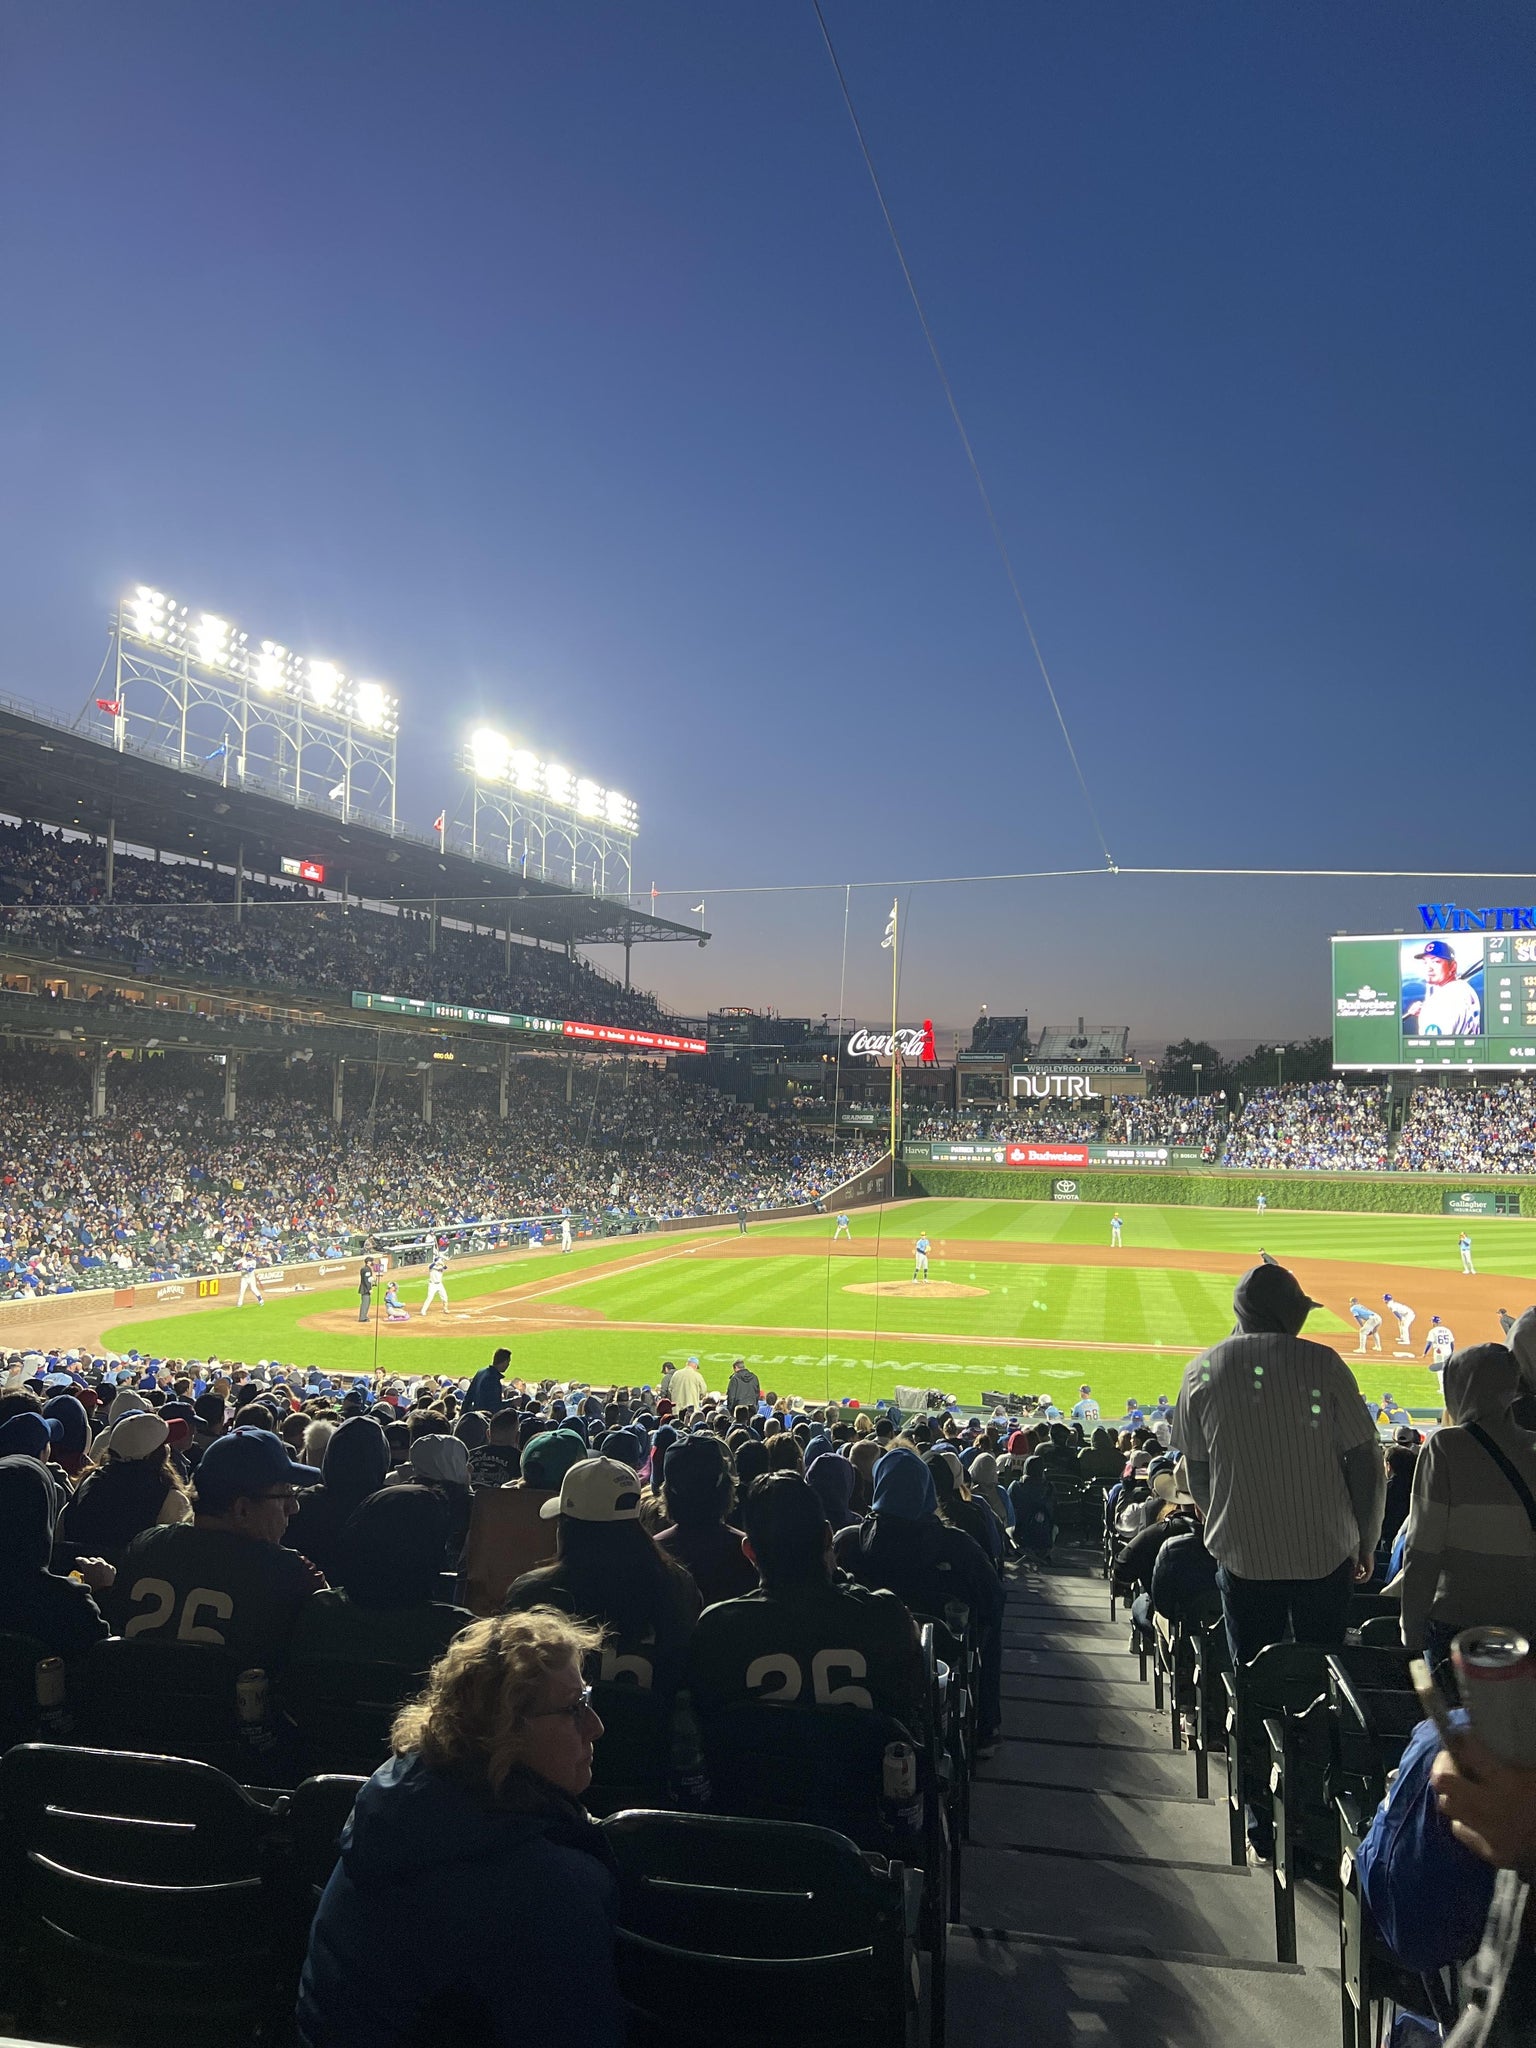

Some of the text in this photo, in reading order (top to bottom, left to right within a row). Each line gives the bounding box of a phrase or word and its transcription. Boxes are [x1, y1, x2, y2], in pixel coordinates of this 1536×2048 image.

[1490, 938, 1504, 948] 27
[847, 1029, 927, 1057] Coca-Cola
[905, 1147, 929, 1155] Harvey
[1028, 1150, 1084, 1162] Budweiser
[1449, 1200, 1487, 1208] Gallagher
[157, 1285, 184, 1299] MARQUEE
[1437, 1334, 1449, 1345] 65
[659, 1349, 1030, 1377] Southwest
[1085, 1408, 1098, 1420] 68
[125, 1577, 233, 1645] 26
[746, 1649, 873, 1709] 26
